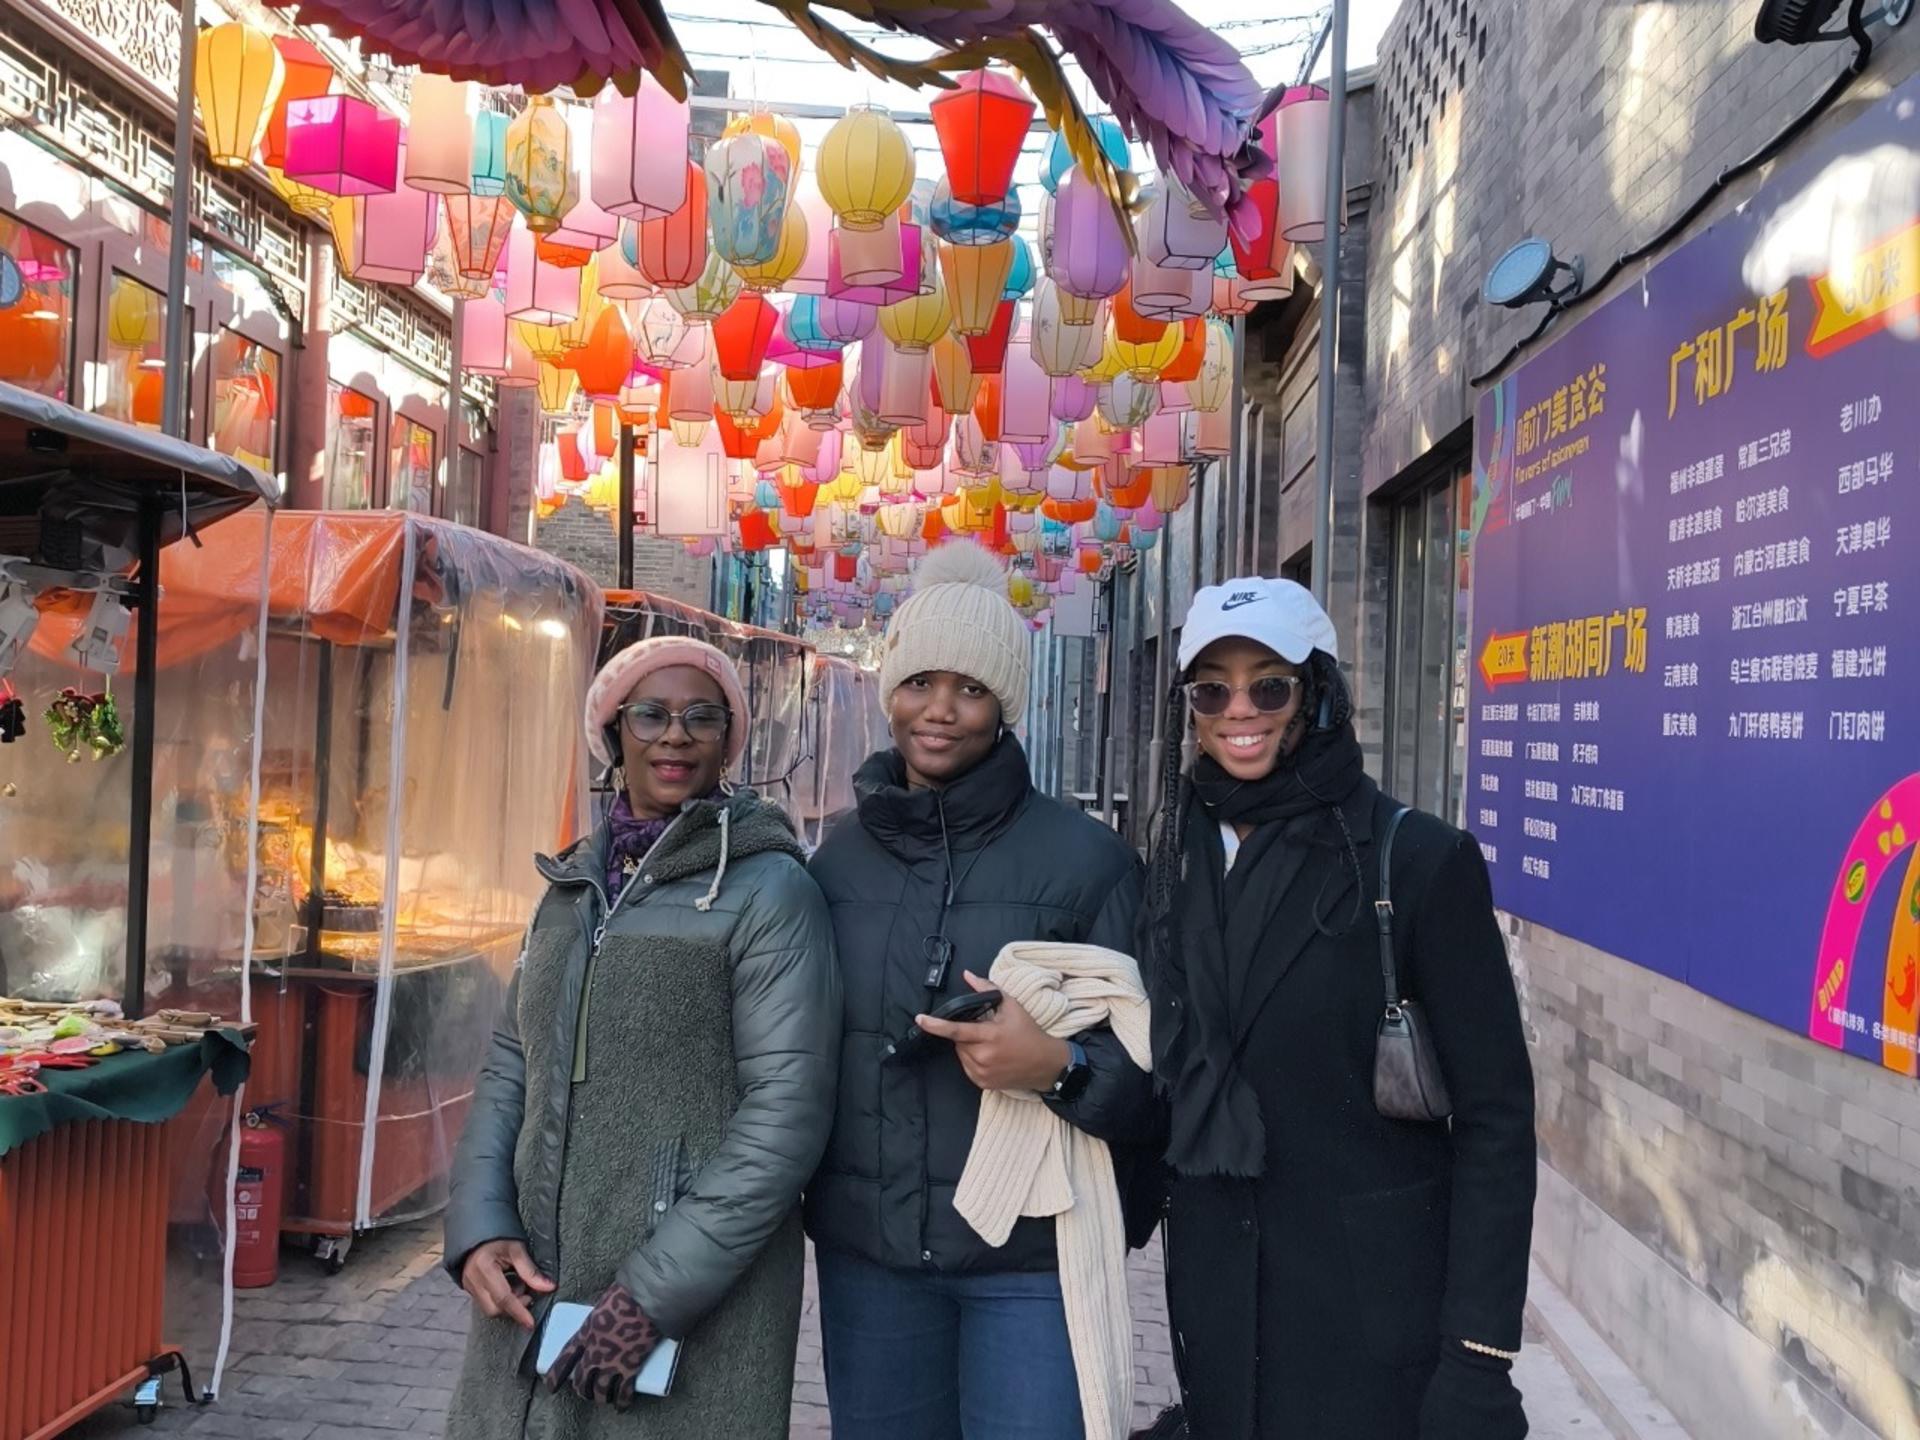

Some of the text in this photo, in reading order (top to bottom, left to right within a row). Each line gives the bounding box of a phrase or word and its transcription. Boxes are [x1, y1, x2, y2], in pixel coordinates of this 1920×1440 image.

[1668, 287, 1788, 420] 广和广场
[1840, 394, 1881, 432] 老川办
[1839, 452, 1893, 494] 西部马华
[1736, 486, 1789, 522] 哈尔滨美食
[1734, 536, 1810, 576] 内蒙古河套美食
[1229, 592, 1257, 601] NIKE
[1834, 581, 1888, 617] 宁夏早茶
[1666, 612, 1699, 638] 青海美食
[1498, 645, 1515, 666] 20米
[1531, 607, 1647, 681] 新潮胡同广场
[1665, 663, 1698, 687] 云南美食
[1731, 653, 1818, 684] 乌兰察布联营烧麦
[1832, 646, 1886, 678] 福建光饼
[1663, 713, 1697, 736] 重庆美食
[1830, 711, 1884, 741] 门钉肉饼
